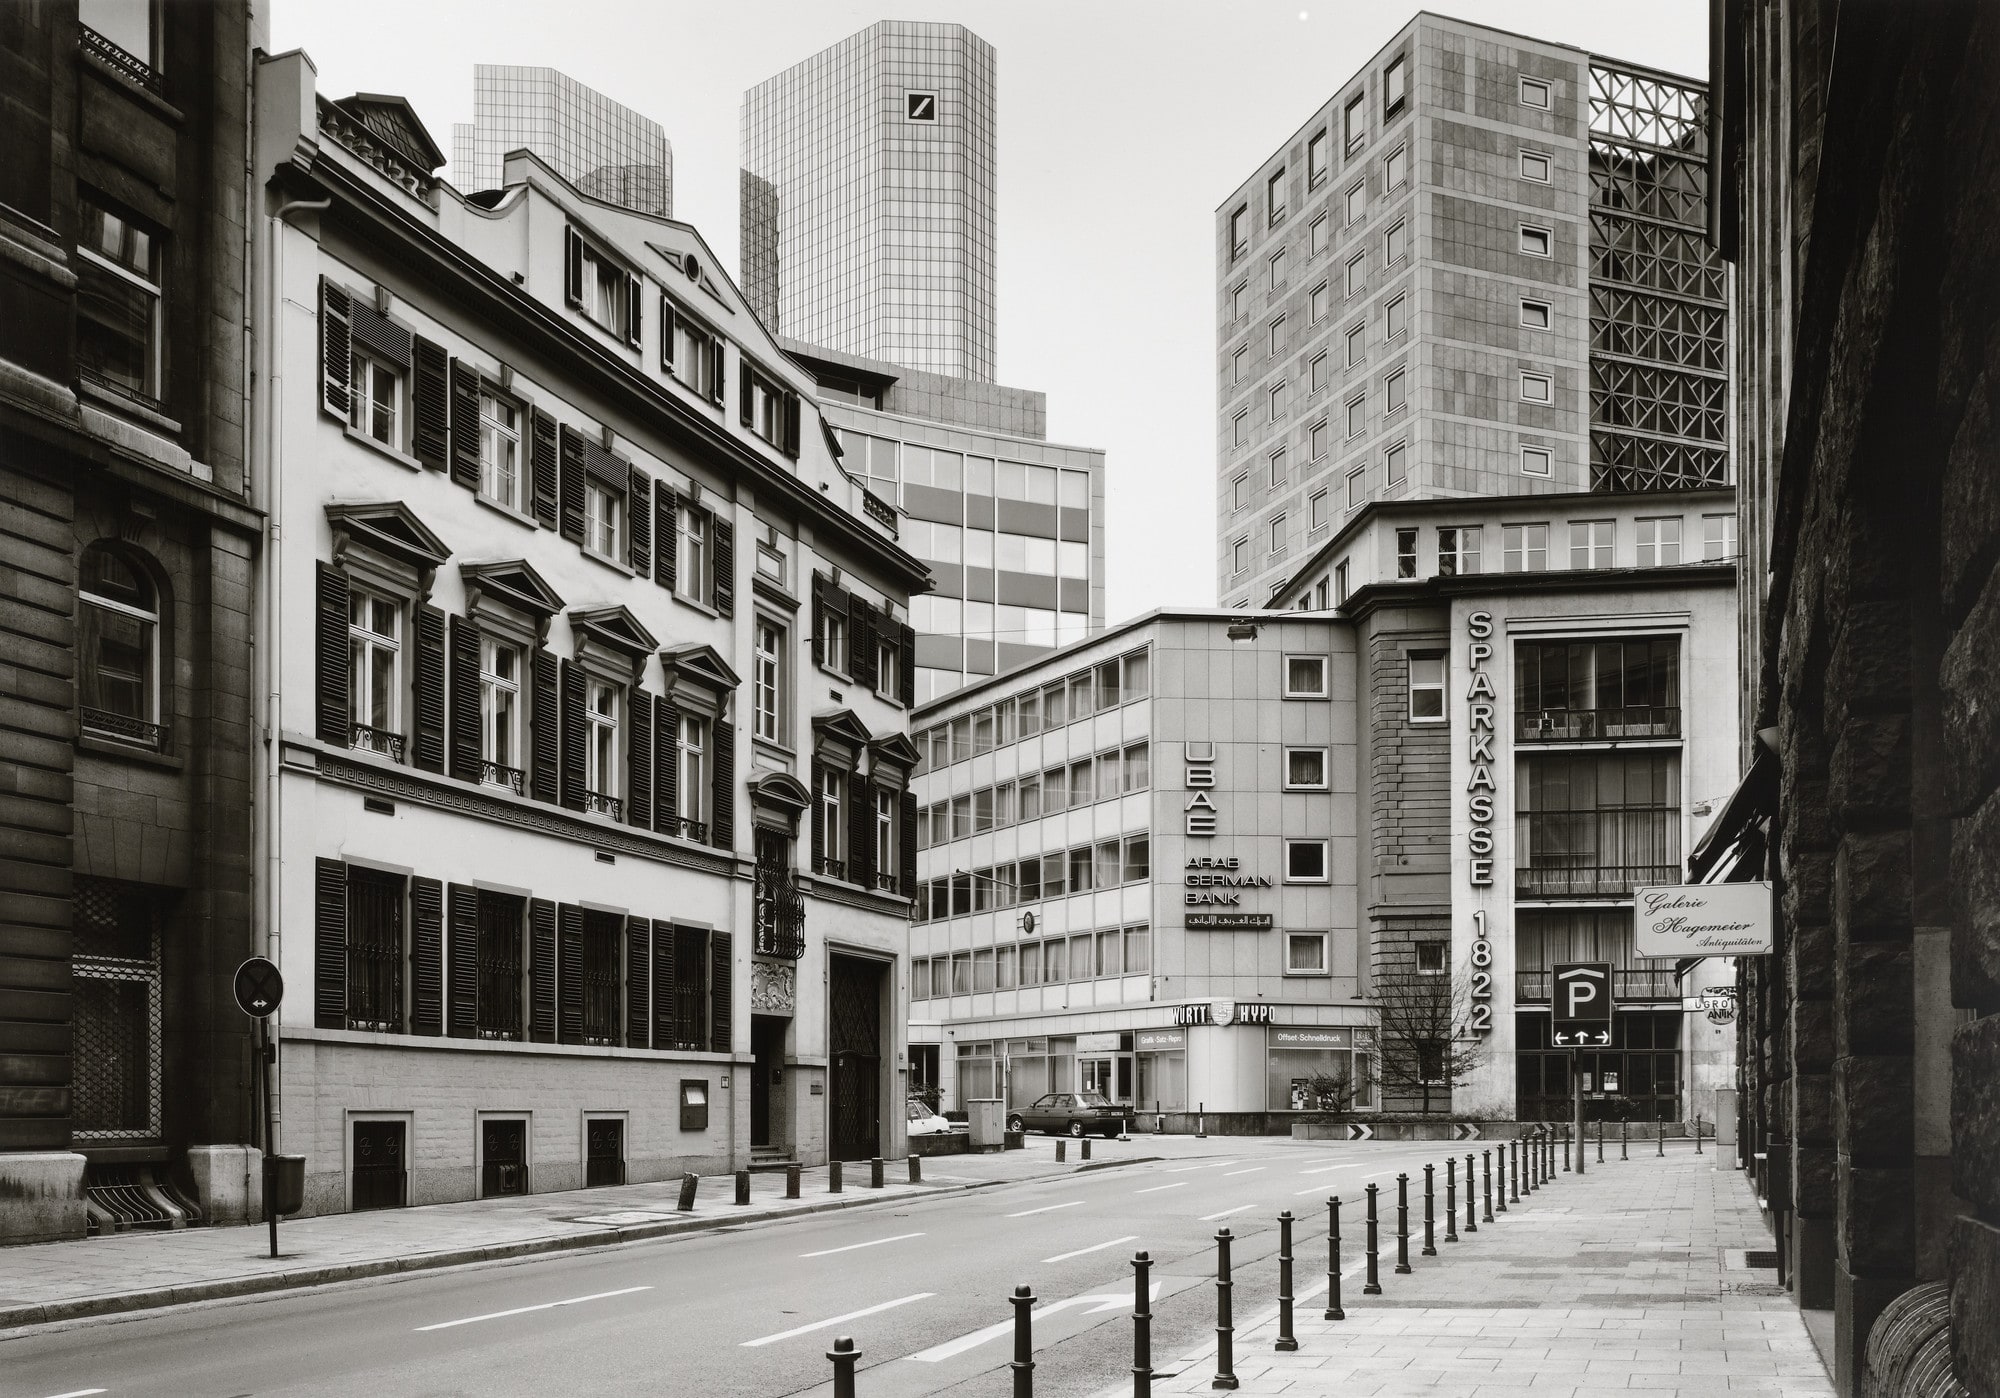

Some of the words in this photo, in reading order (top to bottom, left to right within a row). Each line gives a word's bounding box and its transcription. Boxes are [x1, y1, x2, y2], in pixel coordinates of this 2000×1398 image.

[1467, 611, 1496, 886] SPARKASSE
[1184, 741, 1217, 836] UBAE
[1185, 856, 1240, 869] ARAB
[1185, 874, 1273, 887] GERMAN
[1185, 892, 1240, 905] BANK
[1644, 893, 1708, 917] Galerie
[1652, 916, 1755, 939] Hagemeier
[1696, 935, 1763, 951] Antiquitäten
[1471, 910, 1493, 1031] 1822
[1568, 981, 1597, 1018] P
[1171, 1004, 1206, 1024] WÜRTT
[1240, 1005, 1275, 1023] HYPO
[1707, 1008, 1735, 1019] ANTIK
